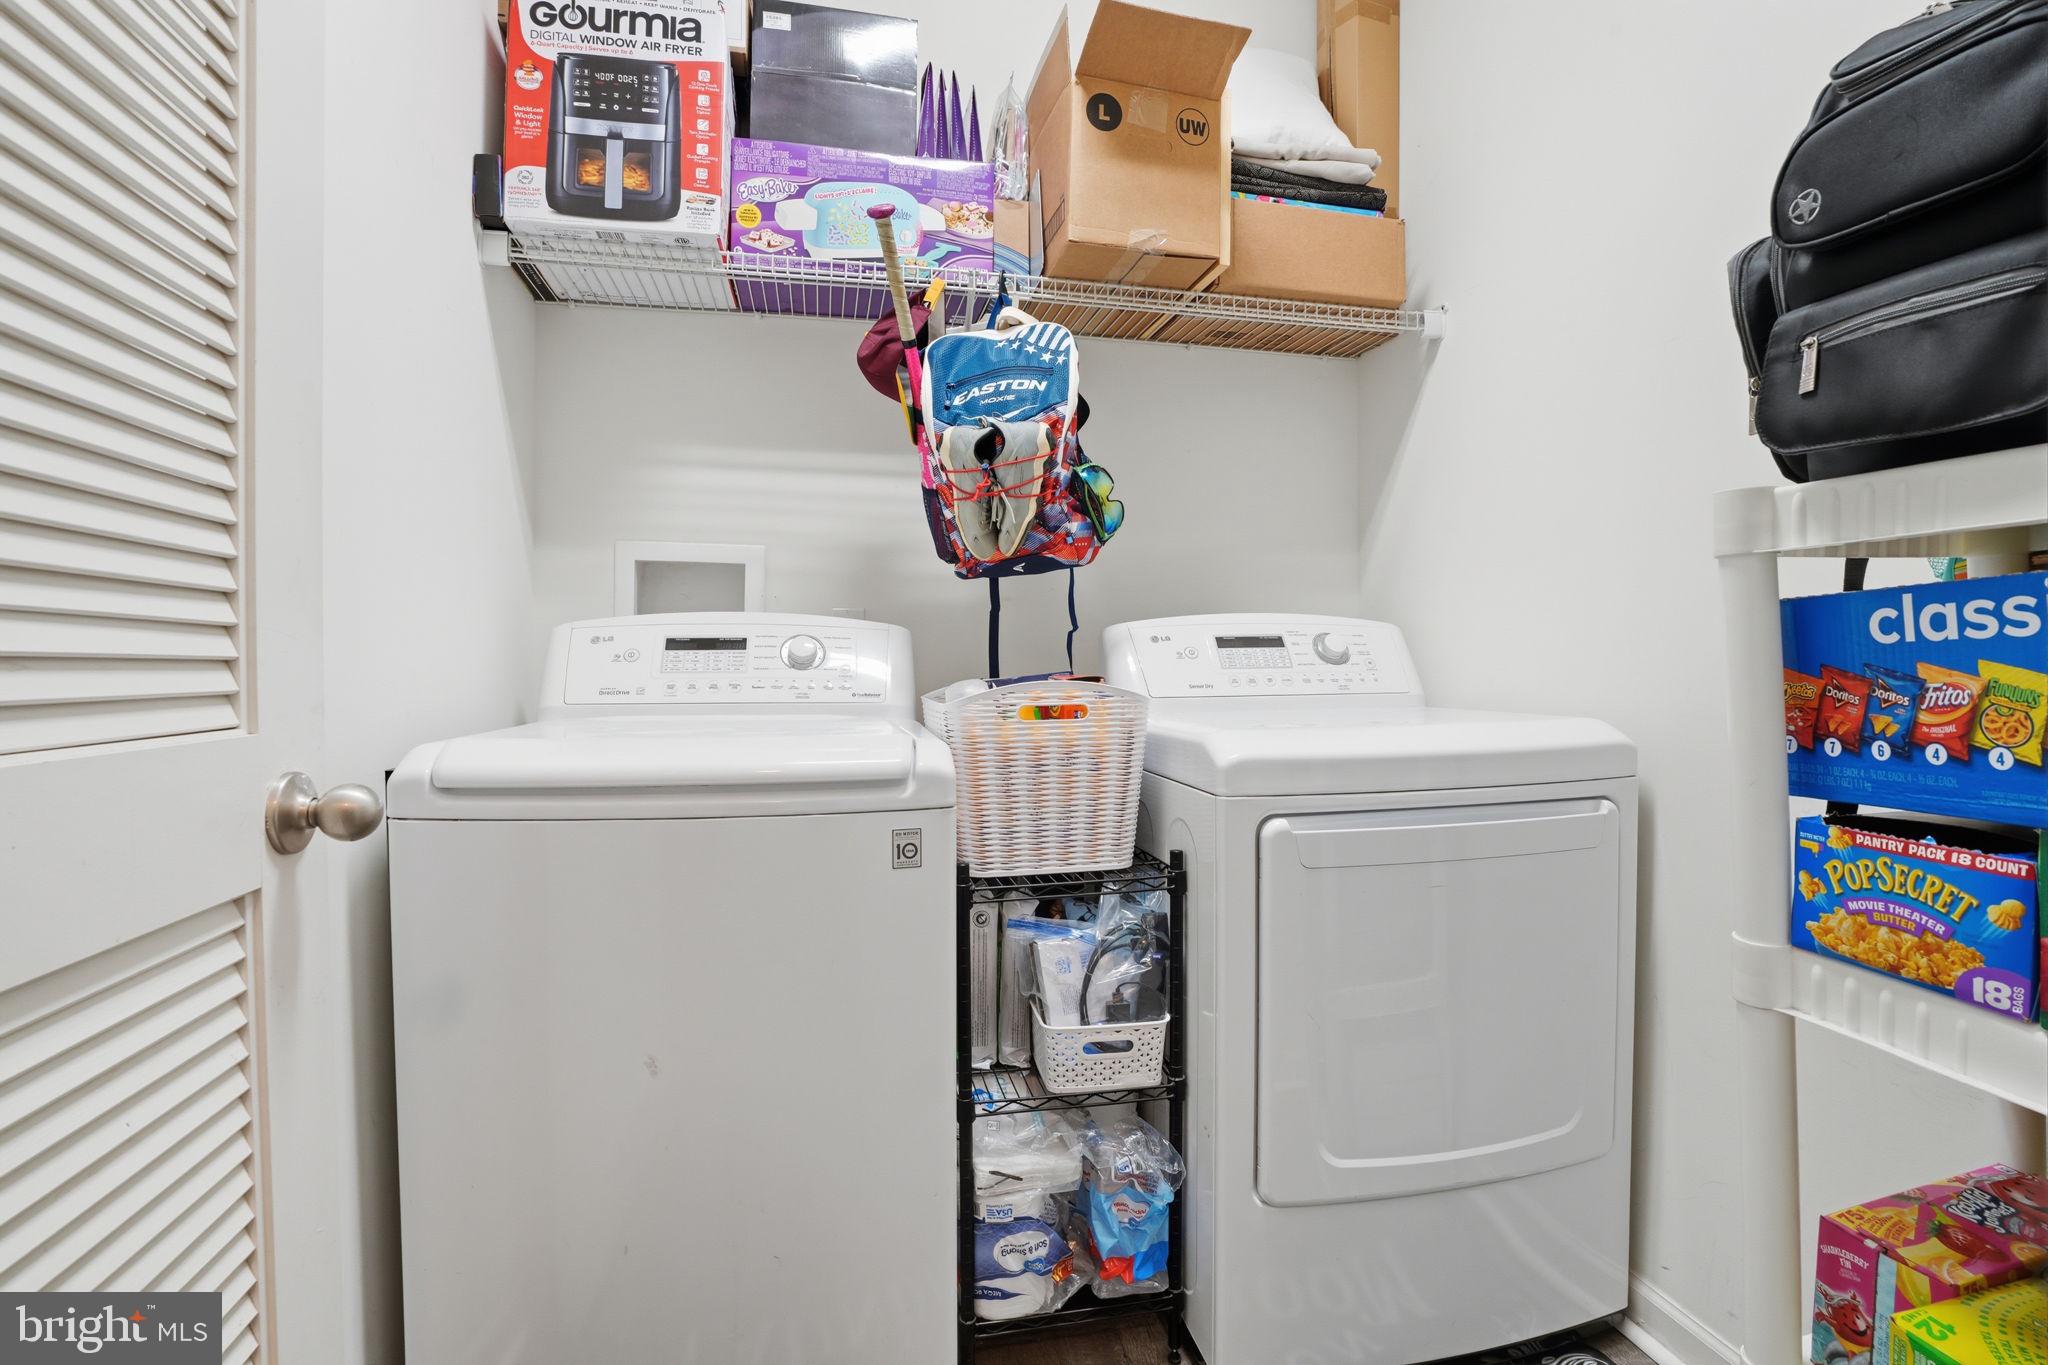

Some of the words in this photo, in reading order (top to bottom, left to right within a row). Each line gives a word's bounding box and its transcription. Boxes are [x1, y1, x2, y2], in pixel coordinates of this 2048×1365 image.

[529, 0, 703, 43] Gourmia
[530, 29, 575, 43] DIGITAL
[580, 34, 637, 49] WINDOW
[641, 41, 661, 52] AIR
[665, 43, 703, 57] FRYER
[514, 112, 543, 120] Window
[1099, 104, 1110, 121] L
[1179, 118, 1207, 137] UW
[952, 379, 1048, 406] EASTON
[980, 394, 1016, 406] MOXIE
[1826, 685, 1861, 706] Doritos
[1870, 686, 1910, 706] Doritos
[1787, 738, 1793, 751] 7
[1829, 741, 1836, 754] 7
[1877, 744, 1885, 757] 6
[1932, 748, 1940, 762] 4
[1996, 752, 2006, 767] 4
[1856, 834, 1904, 852] PANTRY
[1908, 843, 1946, 862] PACK
[1951, 852, 1972, 866] 18
[1975, 856, 2029, 877] COUNT
[1847, 900, 1886, 912] MOVIE
[1887, 903, 1947, 936] THEATER
[1873, 912, 1917, 932] BUTTER
[1972, 976, 2012, 1010] 18
[2012, 986, 2026, 1015] BAGS
[996, 1208, 1013, 1216] USA
[1001, 1246, 1027, 1257] Strong
[1028, 1246, 1034, 1255] &
[1034, 1239, 1048, 1252] Soft
[1914, 1315, 1957, 1341] 12
